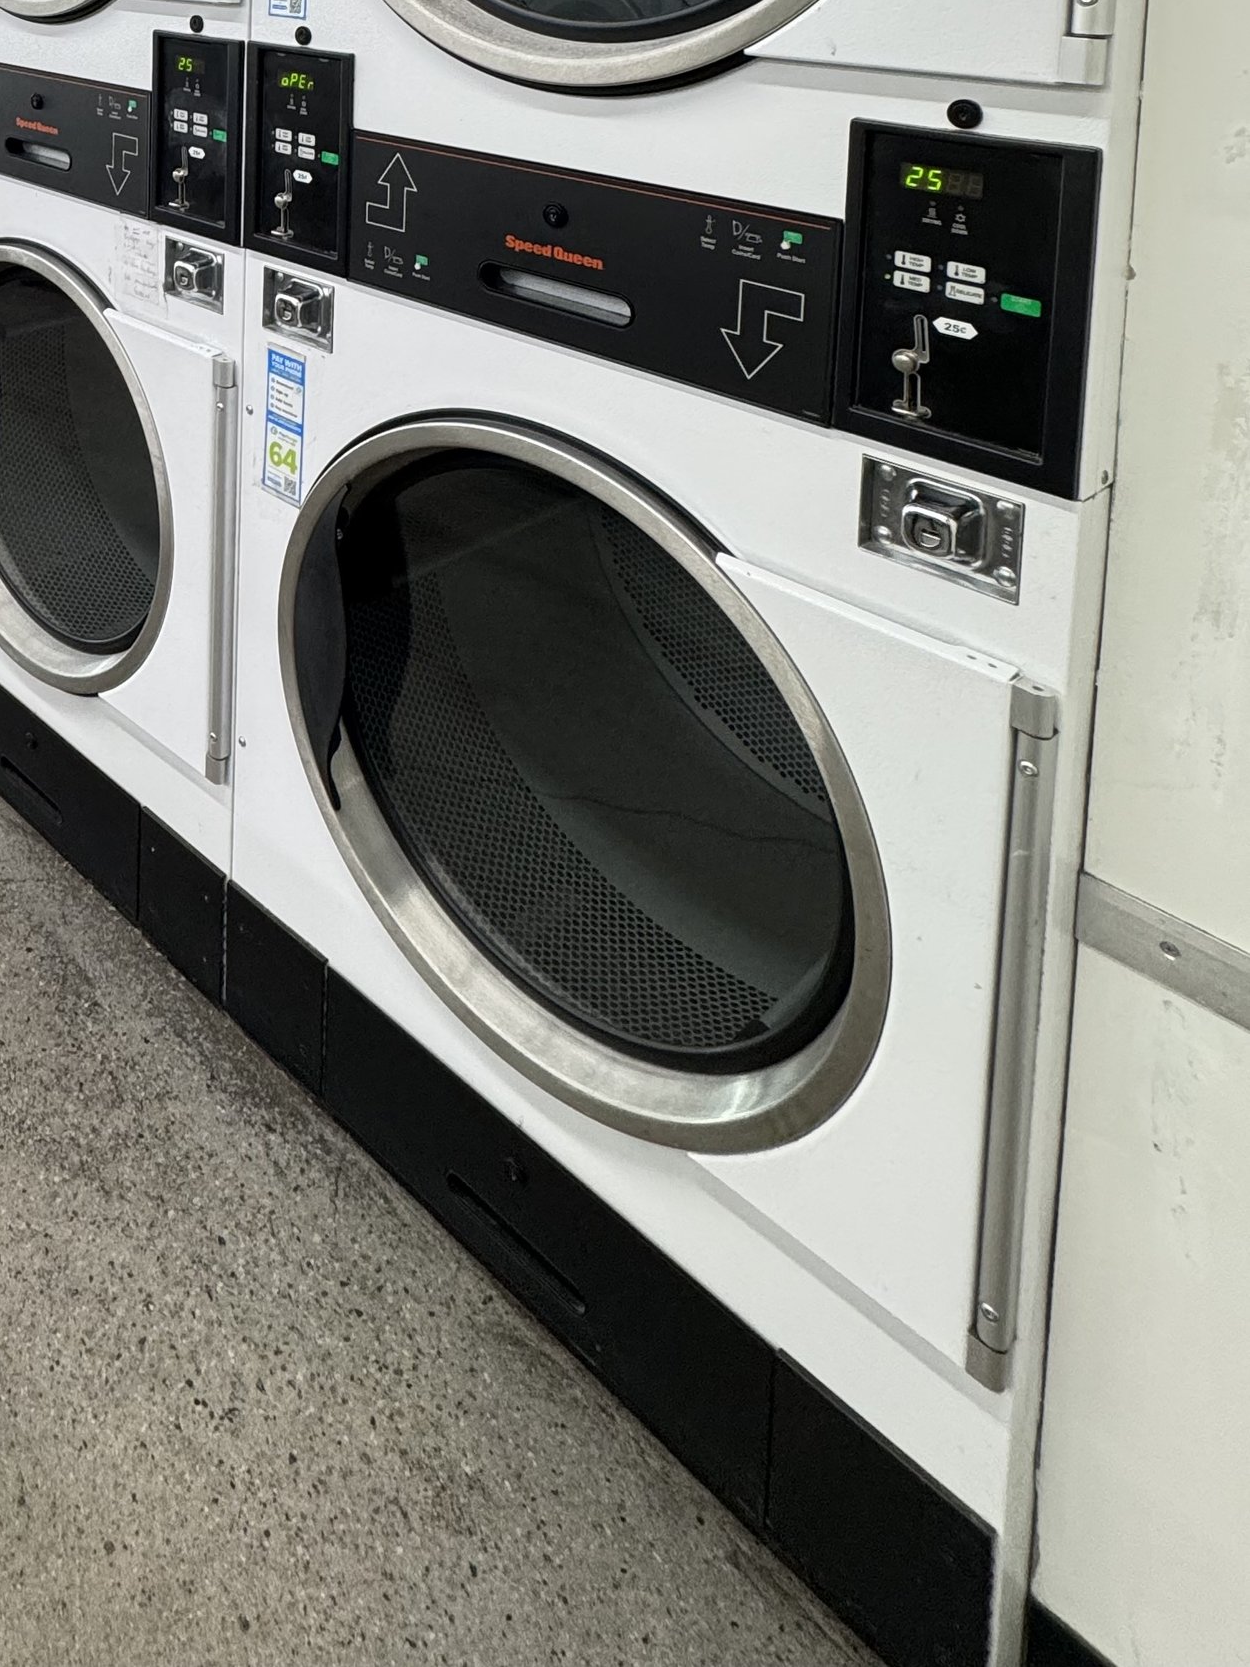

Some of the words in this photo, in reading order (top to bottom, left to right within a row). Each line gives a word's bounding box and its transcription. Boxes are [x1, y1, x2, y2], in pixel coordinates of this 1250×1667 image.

[178, 57, 193, 72] 25
[905, 166, 942, 191] 25
[505, 234, 552, 257] Speed
[554, 246, 604, 270] Queen
[269, 441, 298, 475] 64
